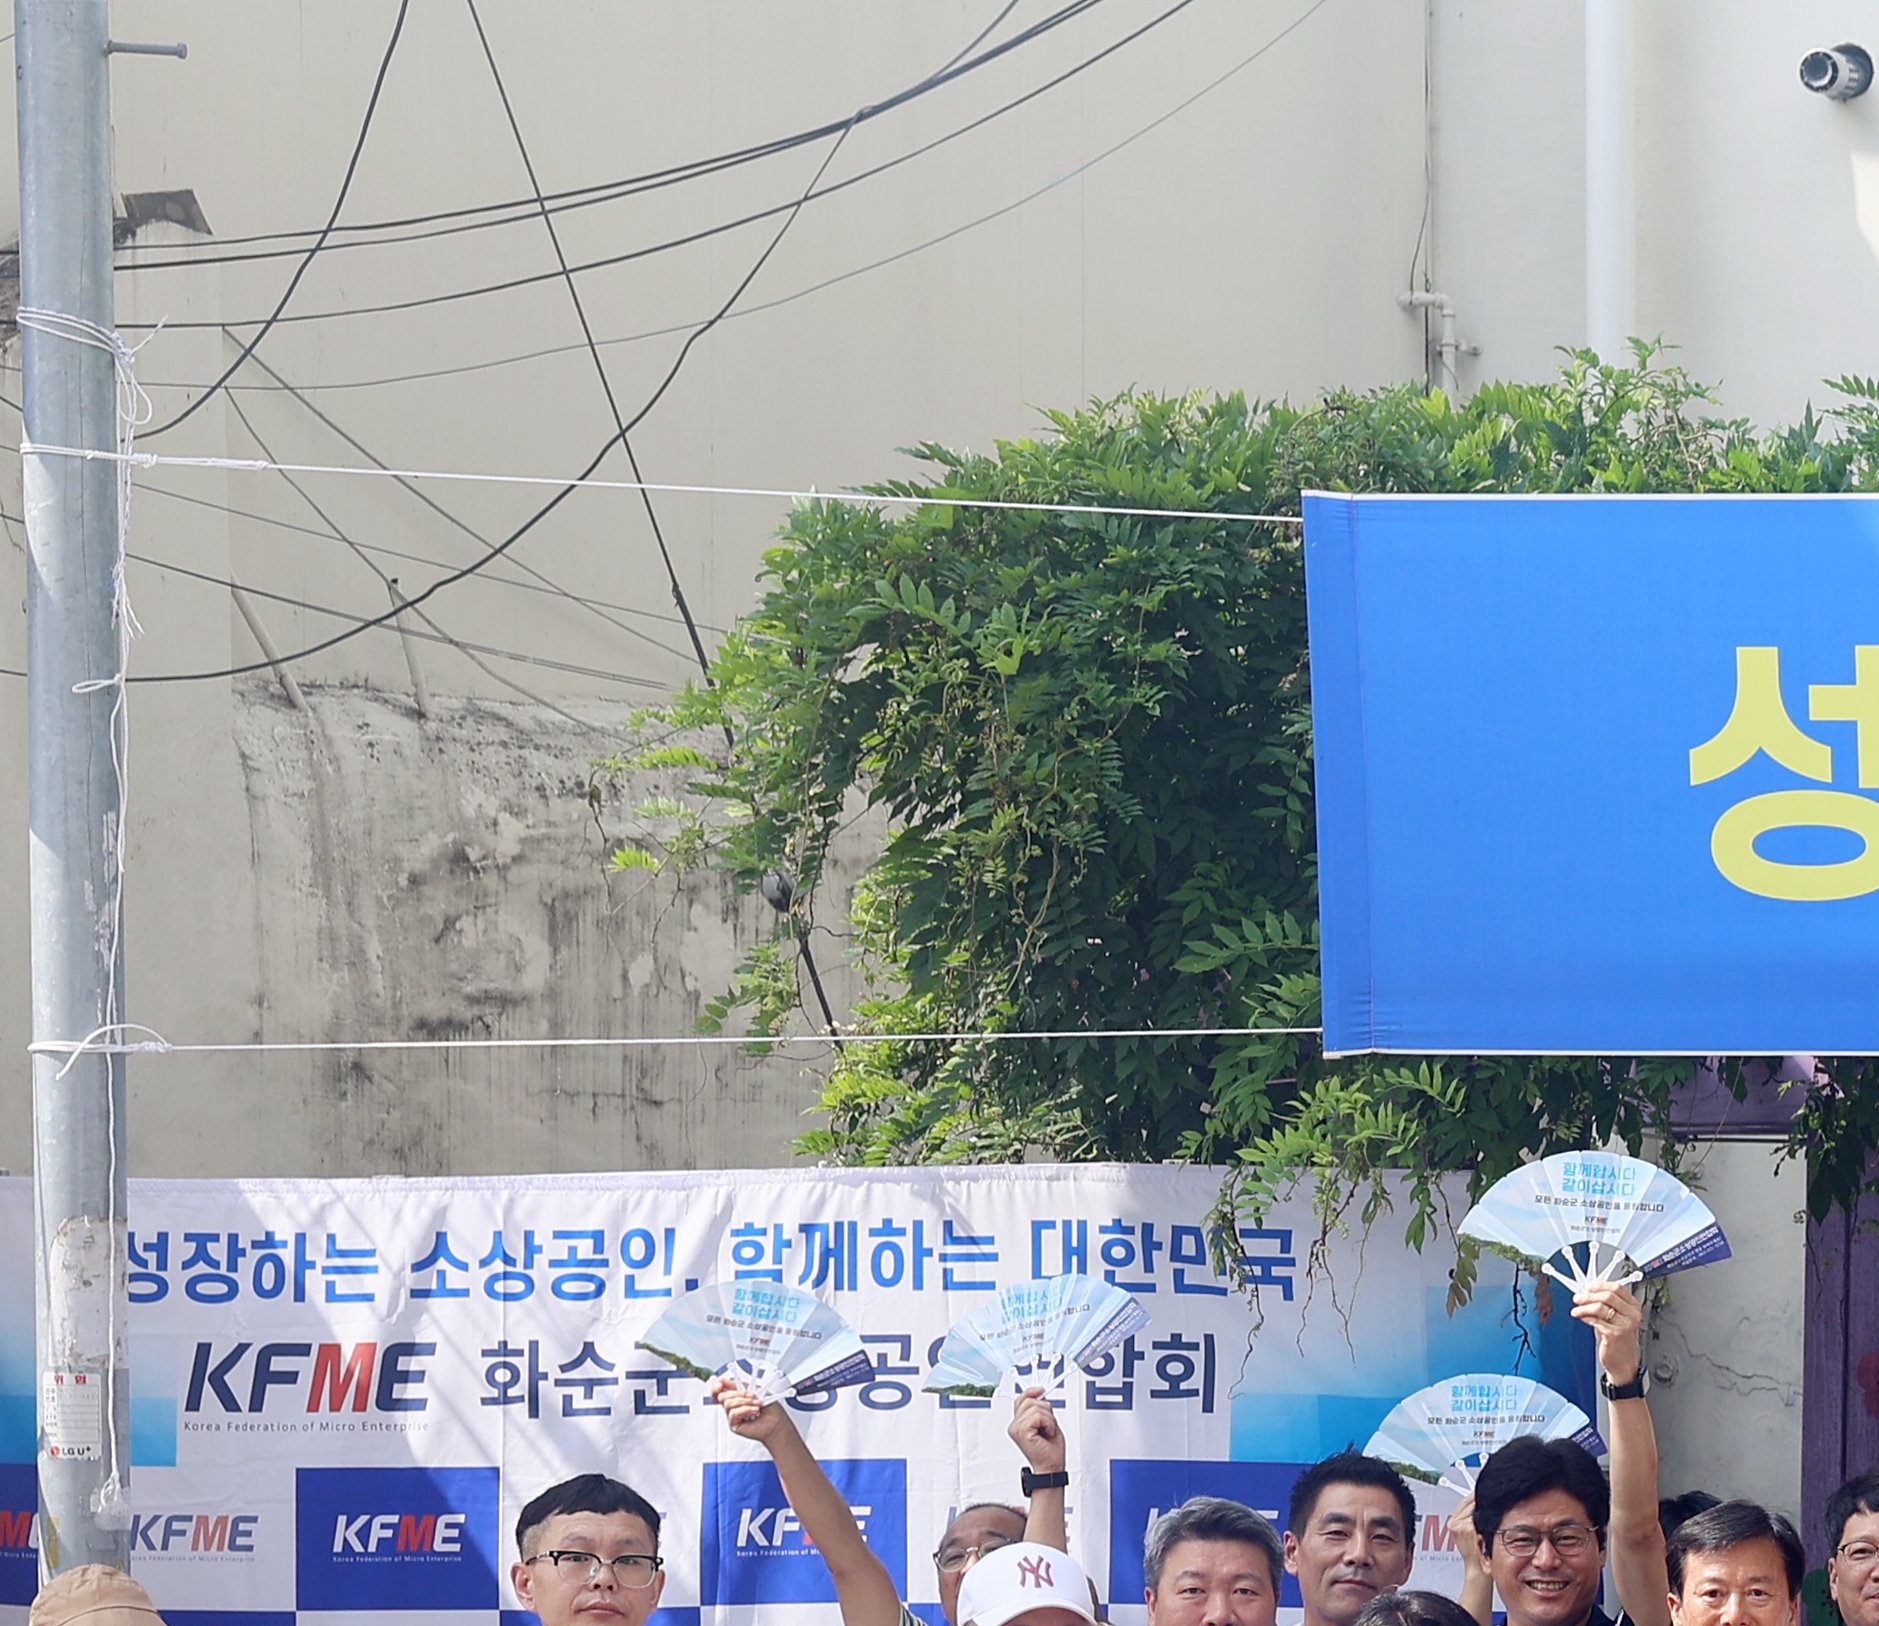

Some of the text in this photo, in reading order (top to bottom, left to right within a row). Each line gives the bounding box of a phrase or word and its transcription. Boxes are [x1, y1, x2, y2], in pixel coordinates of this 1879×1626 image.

[128, 1217, 1295, 1304] 성장하는 소상공인. 함께하는 대한민국
[184, 1341, 437, 1413] KFME
[184, 1419, 429, 1434] Korea Federation of Micro Enterprise
[131, 1514, 258, 1552] KFME
[332, 1513, 465, 1553] KFME
[738, 1507, 870, 1542] KFE
[332, 1555, 462, 1564] Korea Federation of Micro Enterprise
